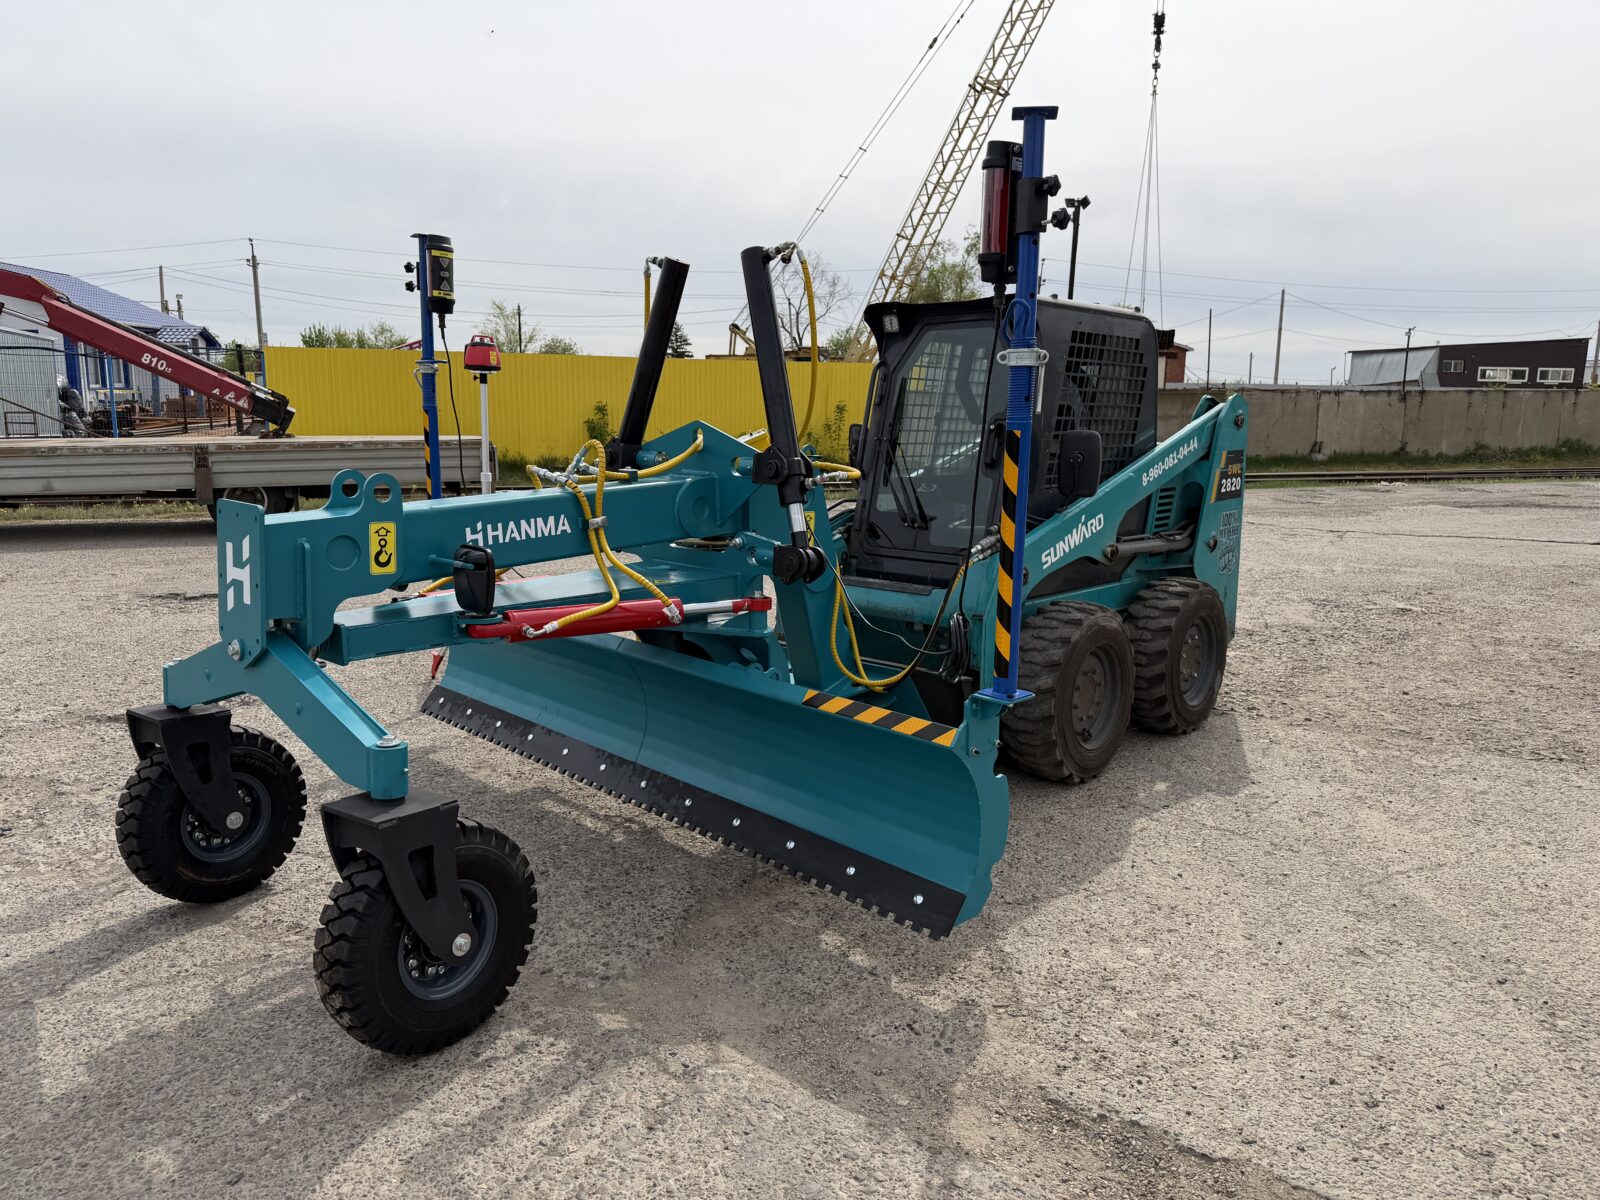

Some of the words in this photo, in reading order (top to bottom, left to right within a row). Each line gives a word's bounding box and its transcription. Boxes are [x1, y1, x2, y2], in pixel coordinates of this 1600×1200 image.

[141, 353, 167, 371] 810
[1142, 436, 1198, 486] 8-960-081-04-44
[1221, 477, 1241, 492] 2820
[486, 514, 572, 546] HANMA
[1041, 513, 1105, 570] SUNWARD
